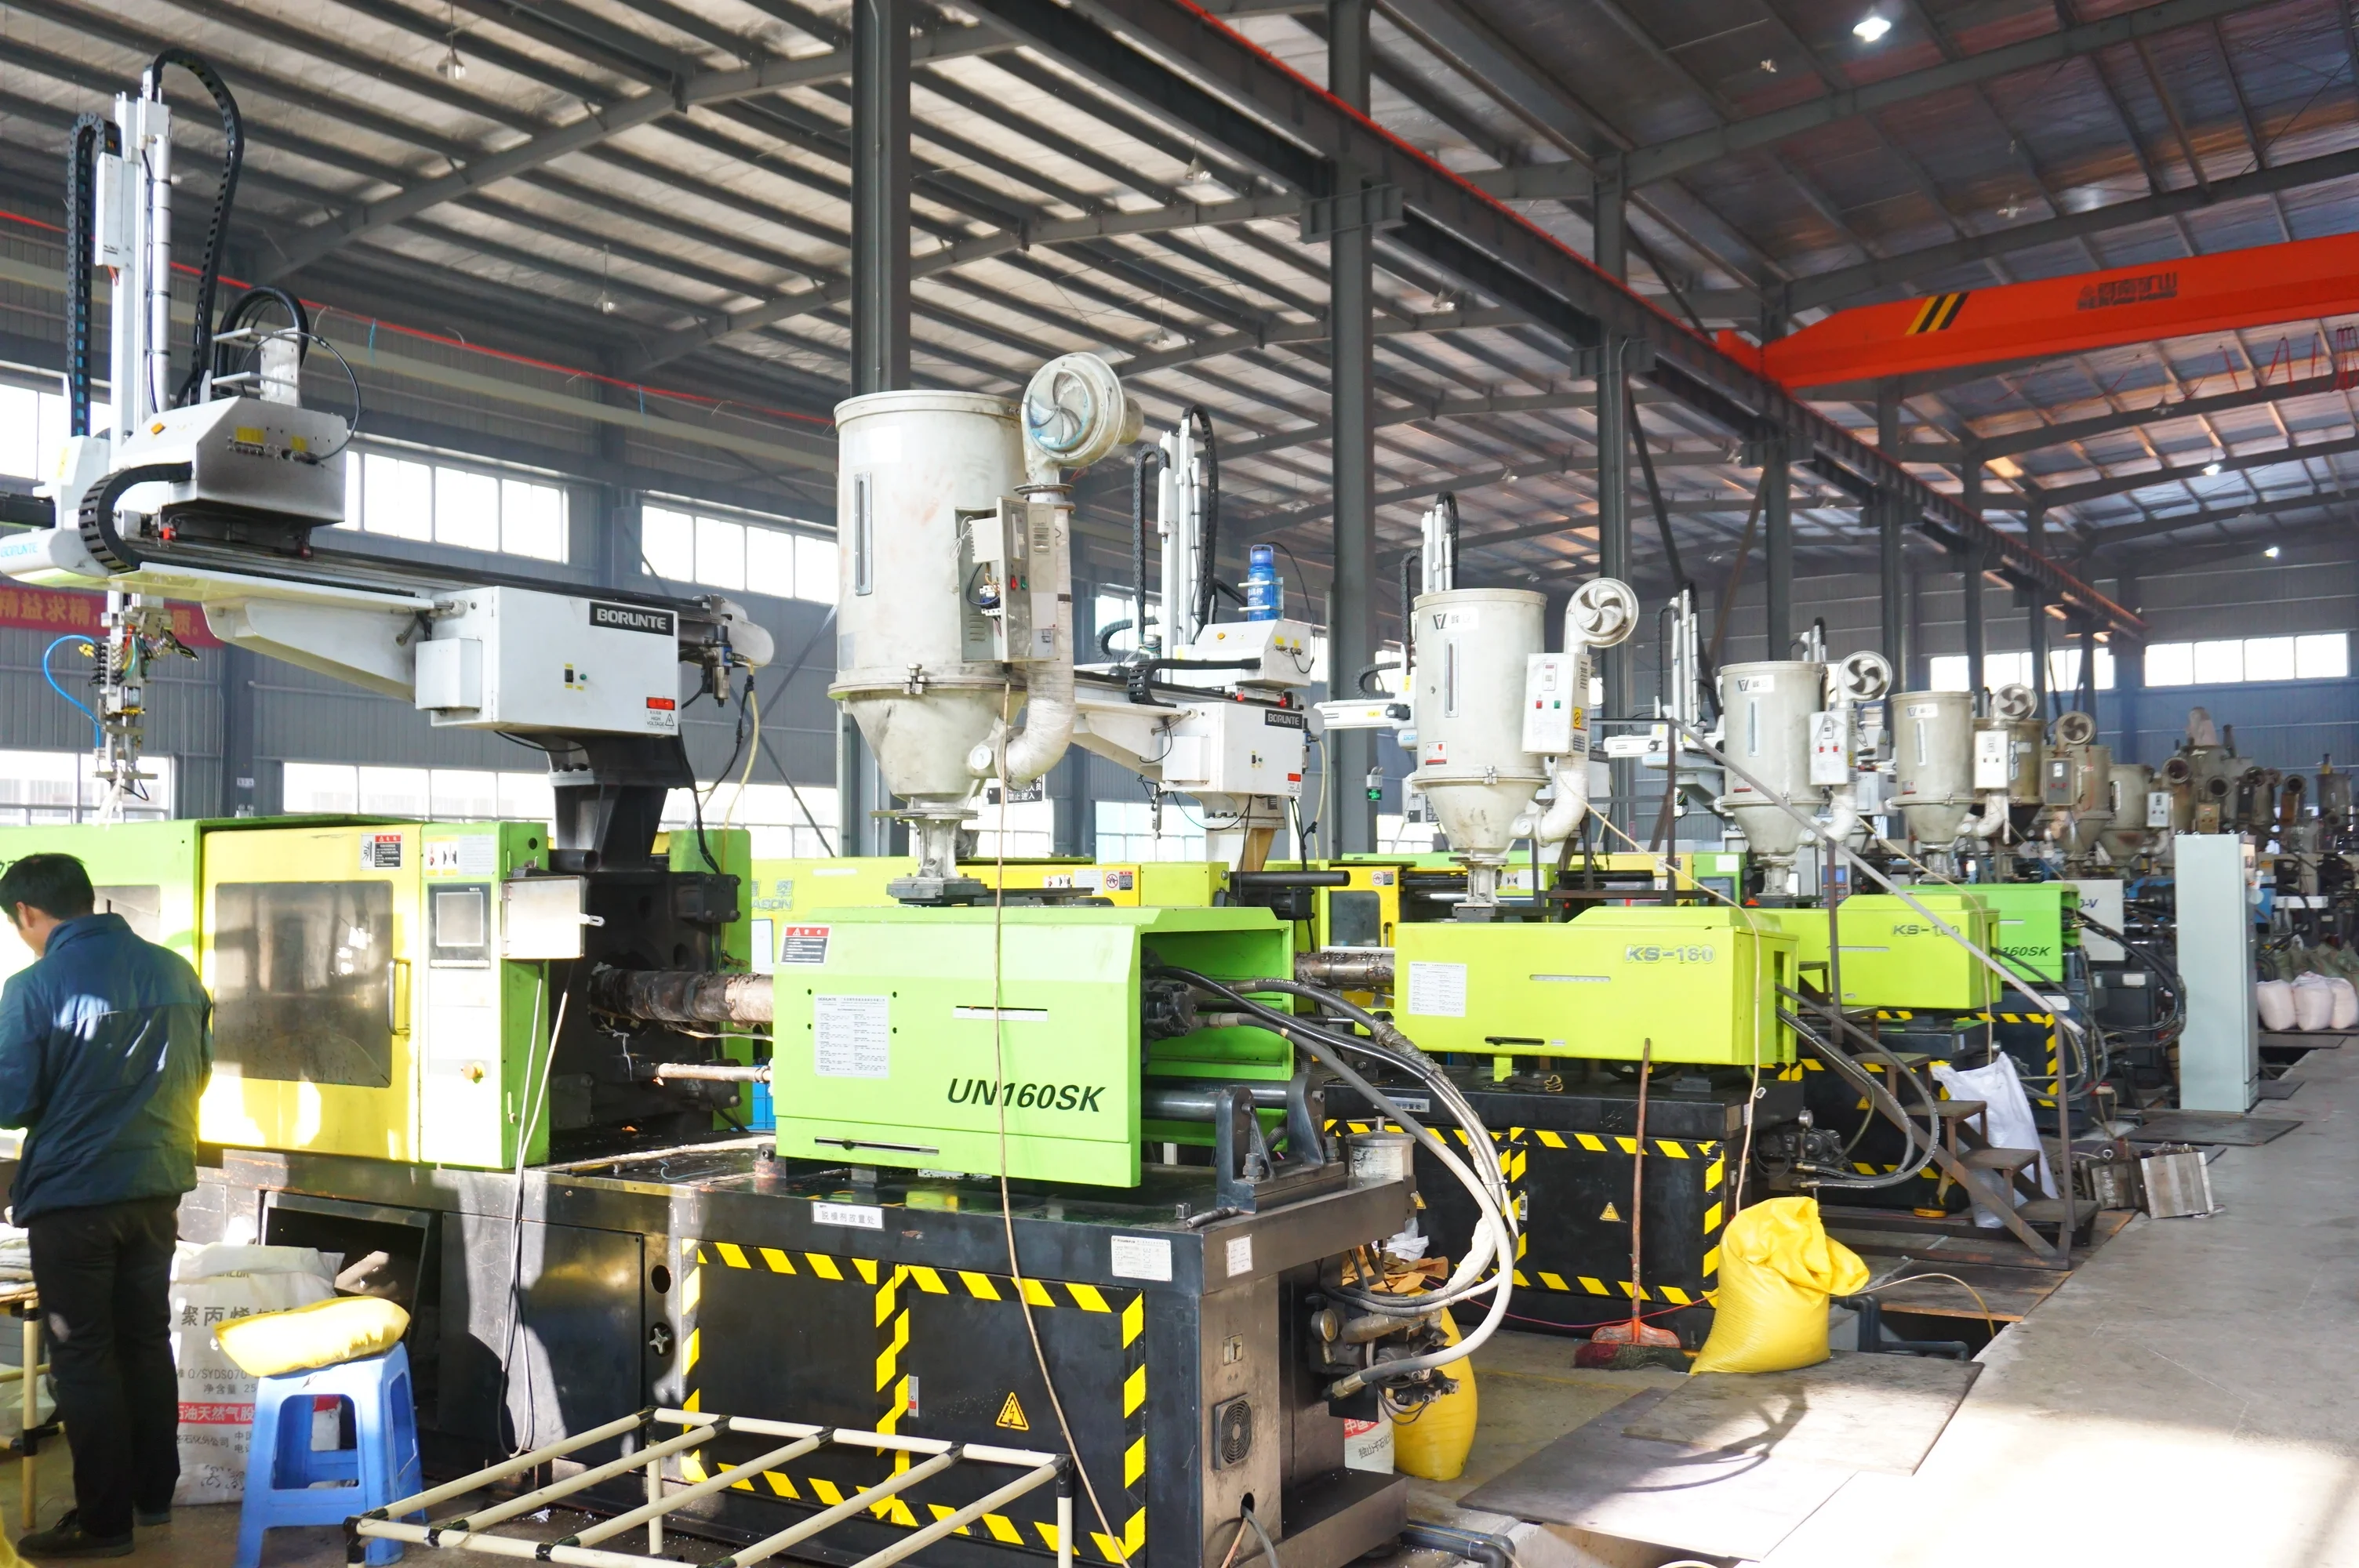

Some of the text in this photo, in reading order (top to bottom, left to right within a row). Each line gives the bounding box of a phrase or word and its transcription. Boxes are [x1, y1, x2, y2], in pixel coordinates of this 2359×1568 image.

[597, 608, 667, 630] BORUNTE
[1267, 713, 1299, 725] BORUNTE
[1008, 792, 1035, 801] 禁止进入
[751, 898, 792, 909] ASON
[1999, 946, 2052, 956] 160SK
[947, 1078, 1107, 1112] UN160SK
[204, 1383, 236, 1395] 净含量
[1345, 1418, 1376, 1434] 中国
